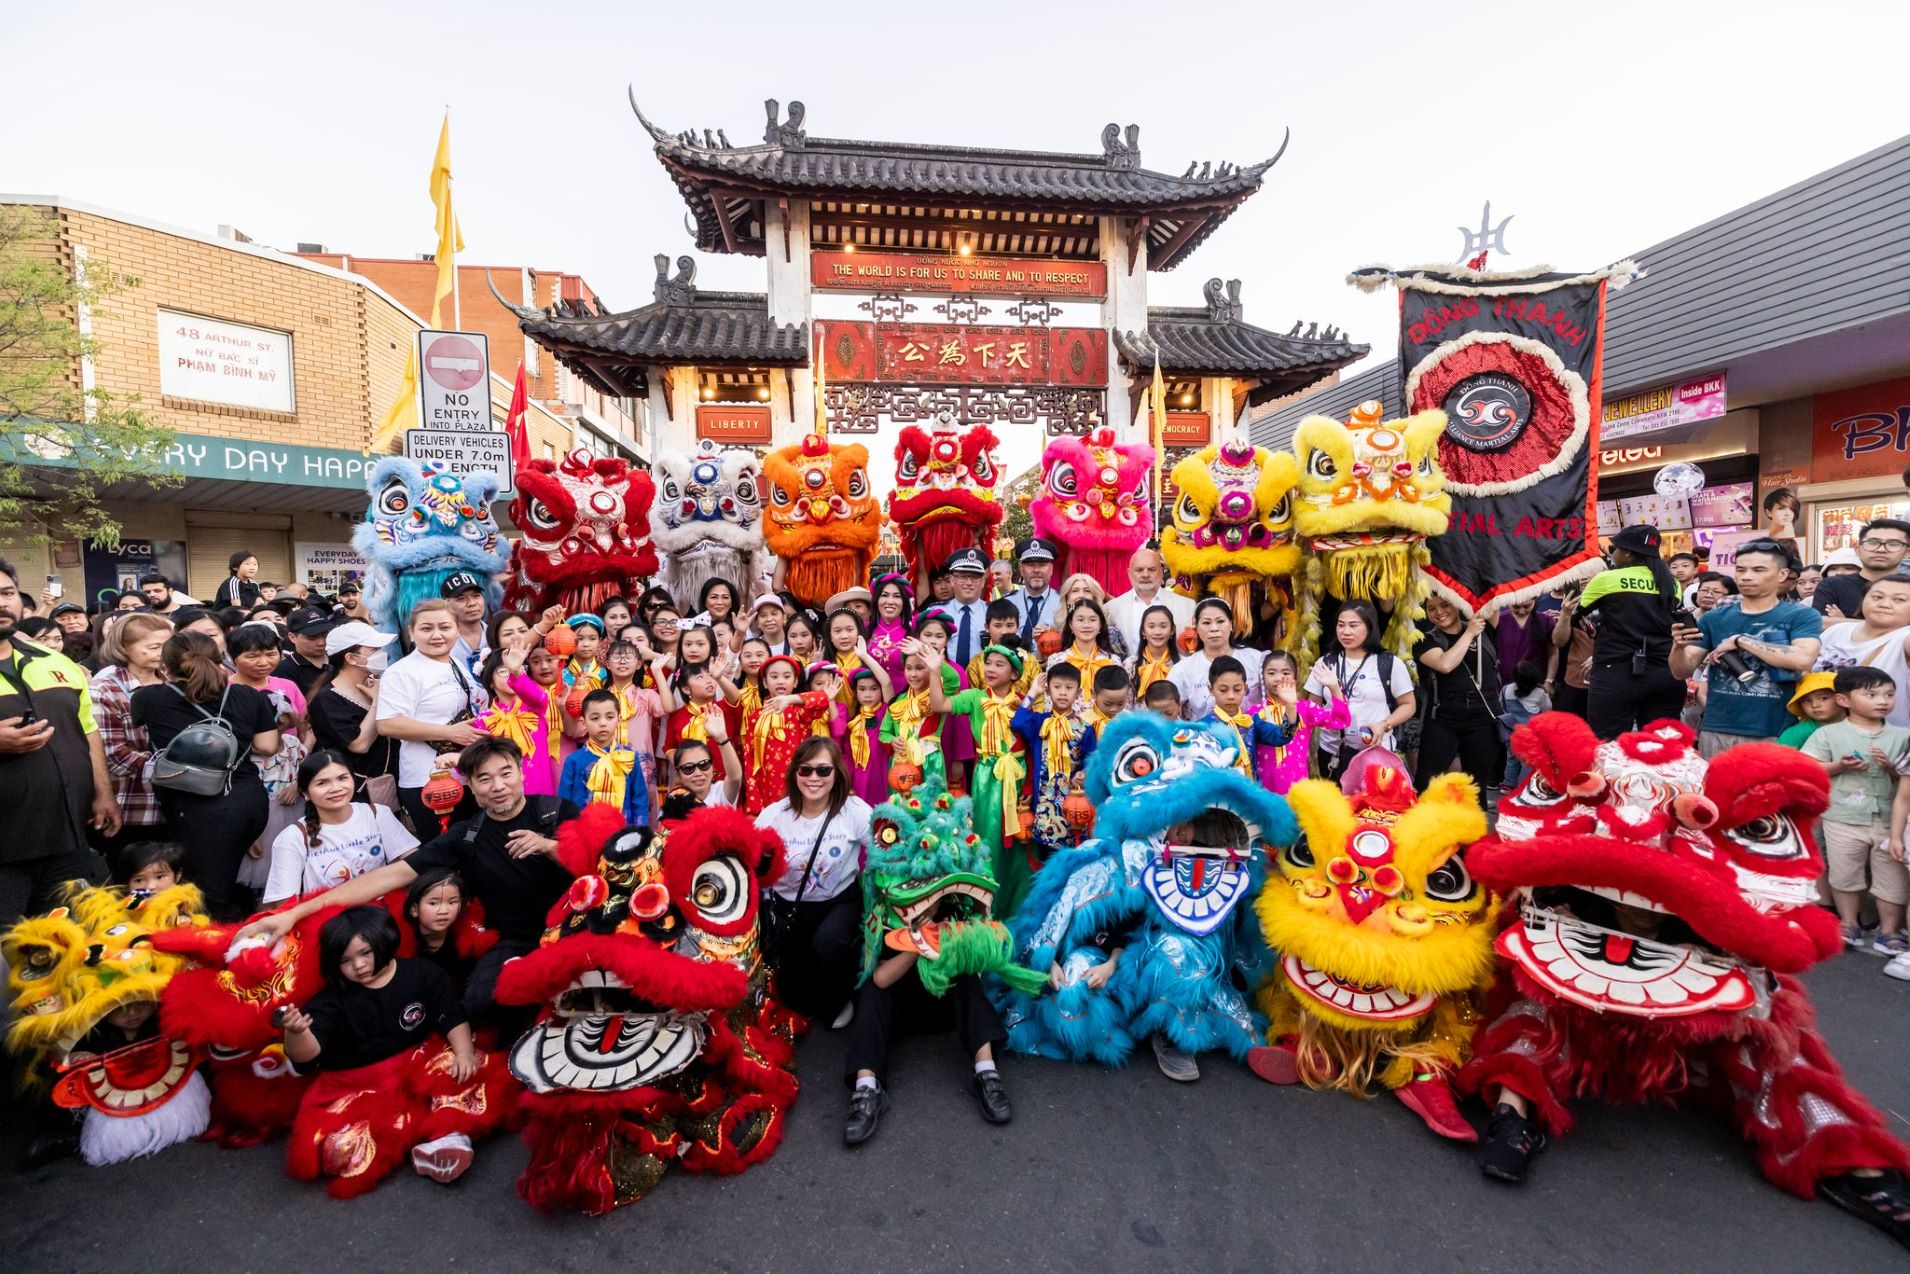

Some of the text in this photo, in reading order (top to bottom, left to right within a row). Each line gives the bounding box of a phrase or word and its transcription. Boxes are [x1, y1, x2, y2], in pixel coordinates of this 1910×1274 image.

[833, 264, 1089, 283] THE WORLD IS FOR US TO SHARE AND TO RESPECT
[1493, 297, 1587, 346] THANH
[177, 327, 274, 352] 48 ARTHUR ST.
[1488, 378, 1518, 392] THANH
[1681, 380, 1720, 399] Inside BKK
[445, 394, 469, 406] NO
[1604, 388, 1673, 422] JEWELLERY
[434, 409, 480, 419] ENTRY
[455, 423, 486, 431] PLAZA
[710, 420, 759, 429] LIBERTY
[1162, 425, 1200, 434] EMOCRACY
[414, 435, 504, 448] DELIVERY VEHICLES
[1475, 433, 1511, 447] MARTIAL
[415, 449, 504, 461] UNDER 7.0m
[225, 447, 288, 474] DAY
[304, 455, 376, 480] HAPP
[451, 463, 498, 473] ENGTH
[1513, 515, 1582, 539] ARTS
[108, 543, 152, 555] Lyca
[1620, 577, 1657, 591] SECU
